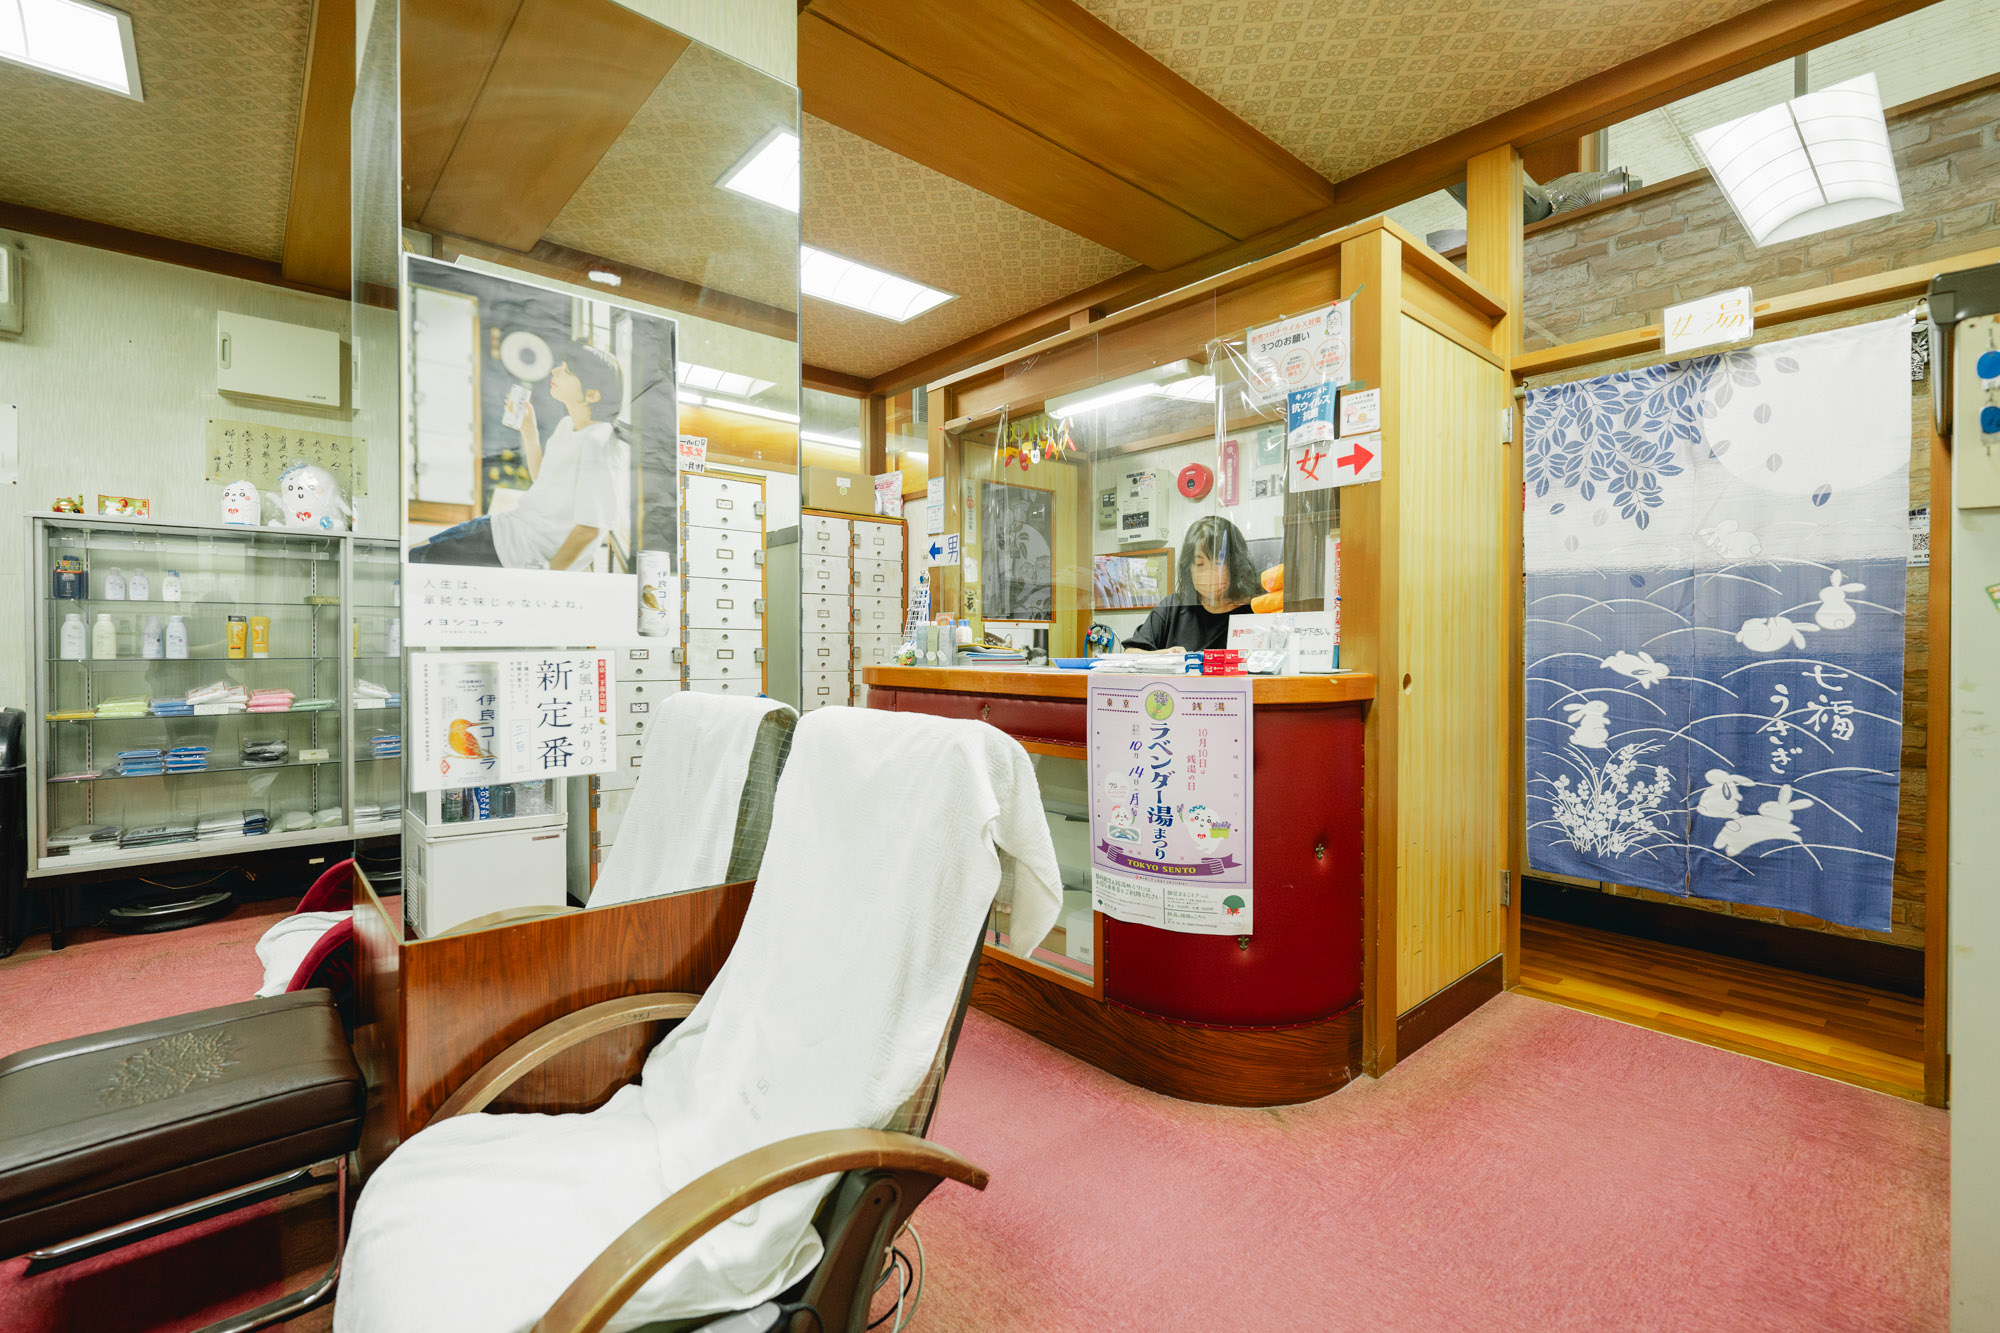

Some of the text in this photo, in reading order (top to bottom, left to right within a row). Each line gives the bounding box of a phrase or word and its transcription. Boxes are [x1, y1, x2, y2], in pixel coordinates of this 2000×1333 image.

[1261, 332, 1310, 352] 3つのお願い
[1291, 394, 1331, 414] 抗ウイルス
[1296, 449, 1327, 481] 女
[947, 534, 959, 563] 男
[423, 578, 478, 591] 人生は、
[536, 660, 575, 770] 新定番
[579, 658, 594, 767] お風呂上がりの
[1106, 697, 1226, 712] 東京 銭湯
[1802, 665, 1854, 741] 七福
[475, 694, 497, 771] 伊良コーラ
[1766, 684, 1803, 774] うさぎ
[1198, 728, 1208, 775] 10月10日は
[1186, 754, 1196, 791] 銭湯の日
[1146, 722, 1176, 861] ラベンダー湯まつり
[1127, 858, 1197, 874] TOKYO SENTO
